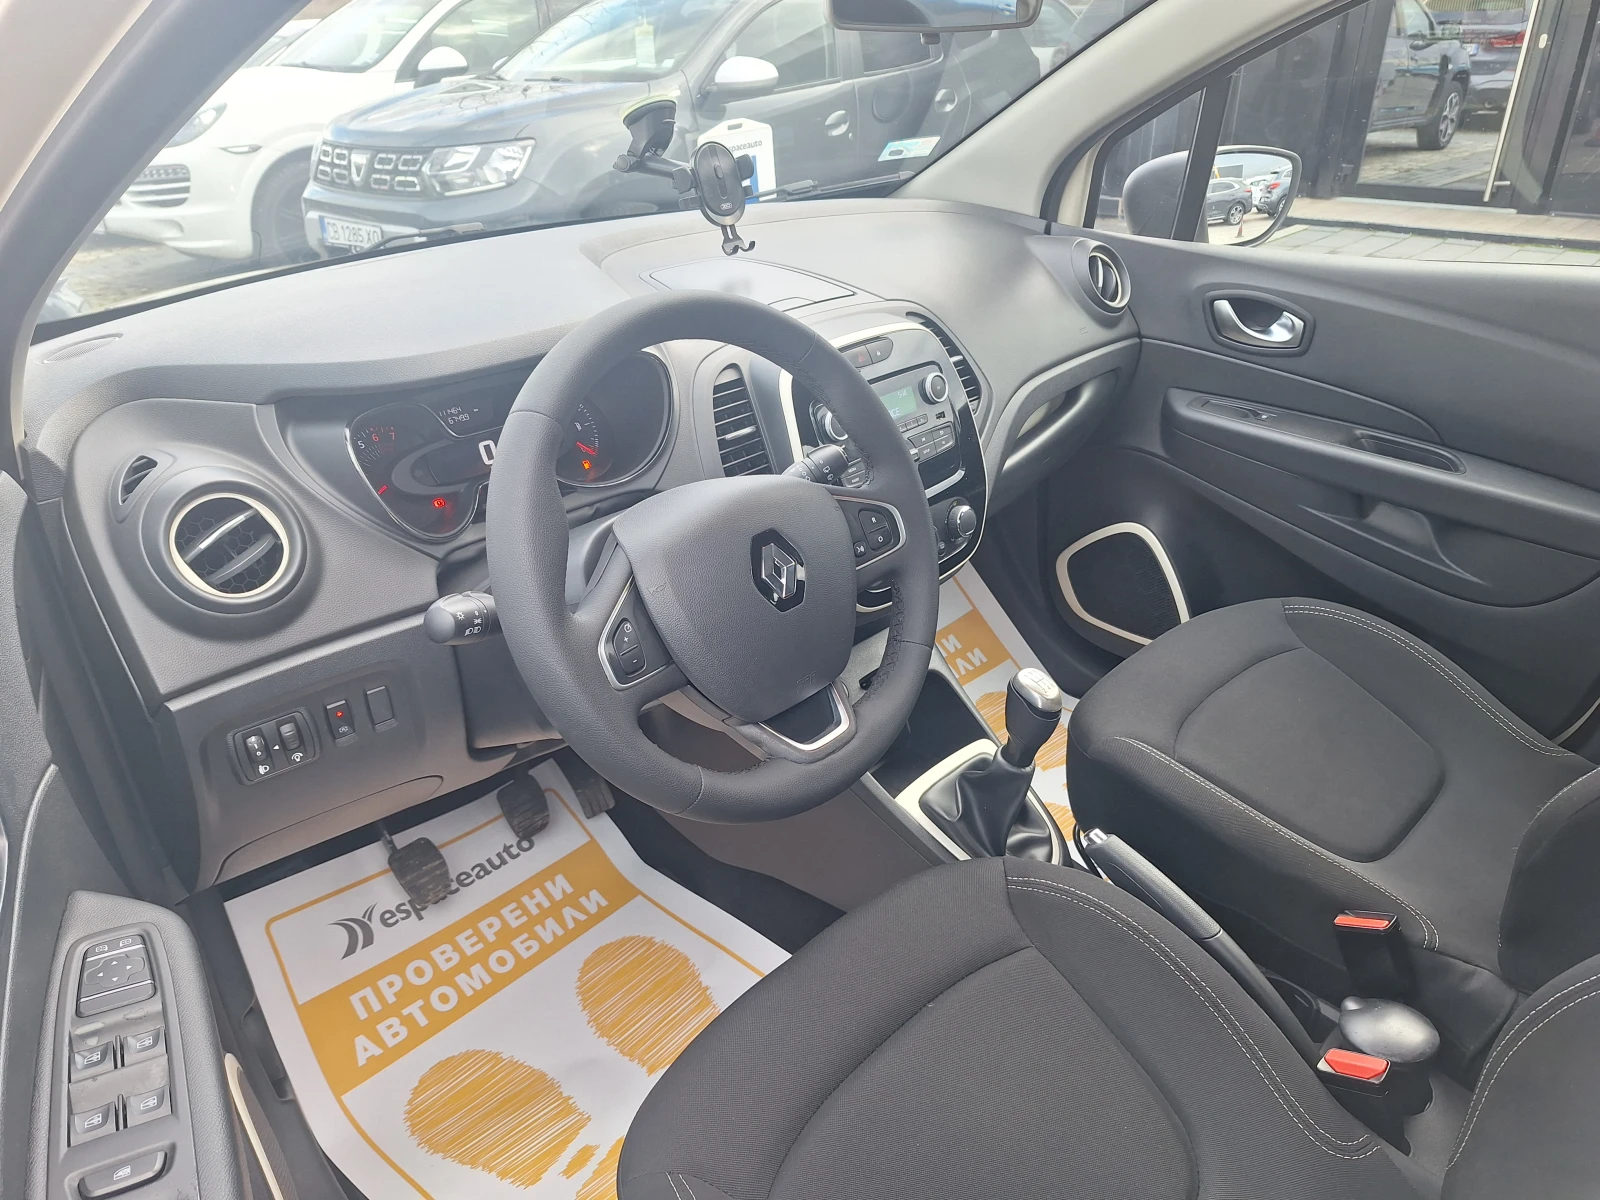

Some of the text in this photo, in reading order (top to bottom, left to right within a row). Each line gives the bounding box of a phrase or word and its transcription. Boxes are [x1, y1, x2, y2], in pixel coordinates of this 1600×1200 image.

[729, 140, 762, 153] spaceauto
[371, 433, 379, 442] 6
[389, 432, 396, 440] 7
[357, 440, 366, 449] 5
[379, 836, 535, 928] espceauto
[349, 873, 574, 1021] ПРОВЕРЕНИ
[353, 888, 609, 1067] АВТОМОБИЛИ
